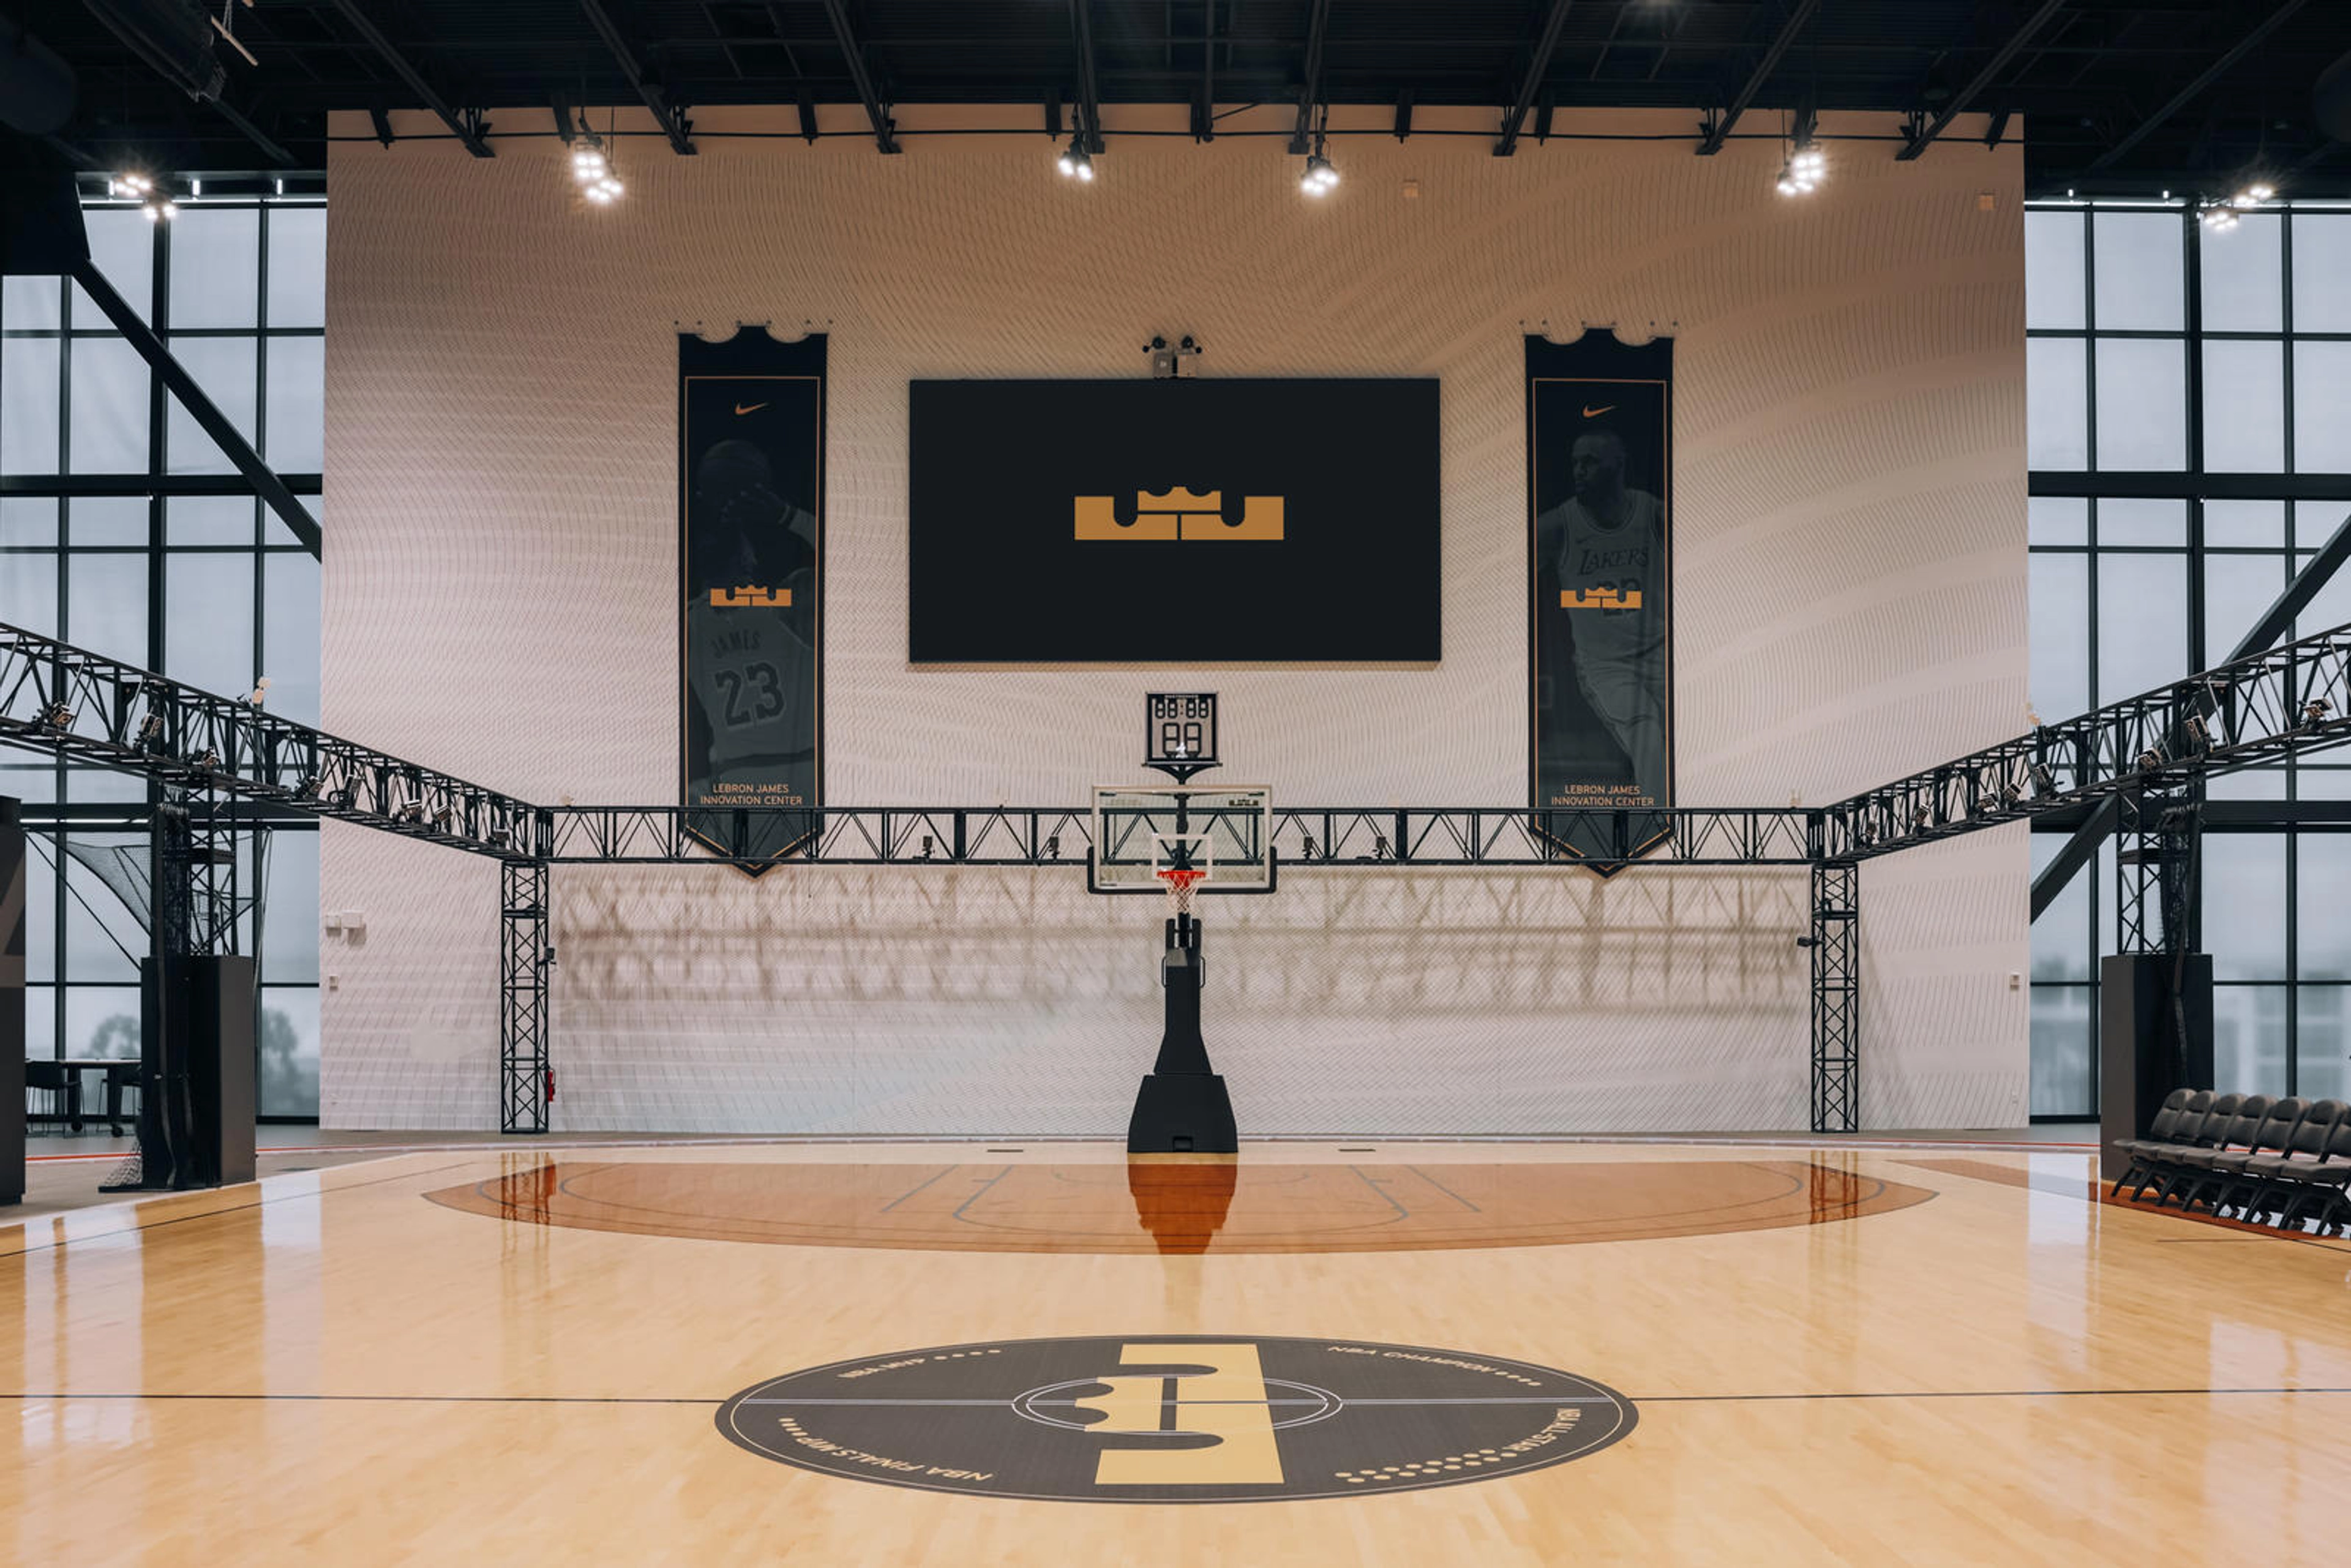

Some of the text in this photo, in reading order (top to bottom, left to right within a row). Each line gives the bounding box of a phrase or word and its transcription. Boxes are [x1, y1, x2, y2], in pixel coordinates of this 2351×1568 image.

[1578, 547, 1651, 576] LAKERS
[709, 629, 762, 659] JAMES
[714, 661, 786, 729] 23
[700, 795, 803, 806] INNOVATION CENTER
[713, 783, 789, 793] LEBRON JAMES
[1551, 796, 1654, 806] INNOVATION CENTER
[1565, 784, 1641, 795] LEBRON JAMES
[1327, 1346, 1498, 1373] NBA CHAMPION
[796, 1438, 994, 1481] NBA FINALS MVP
